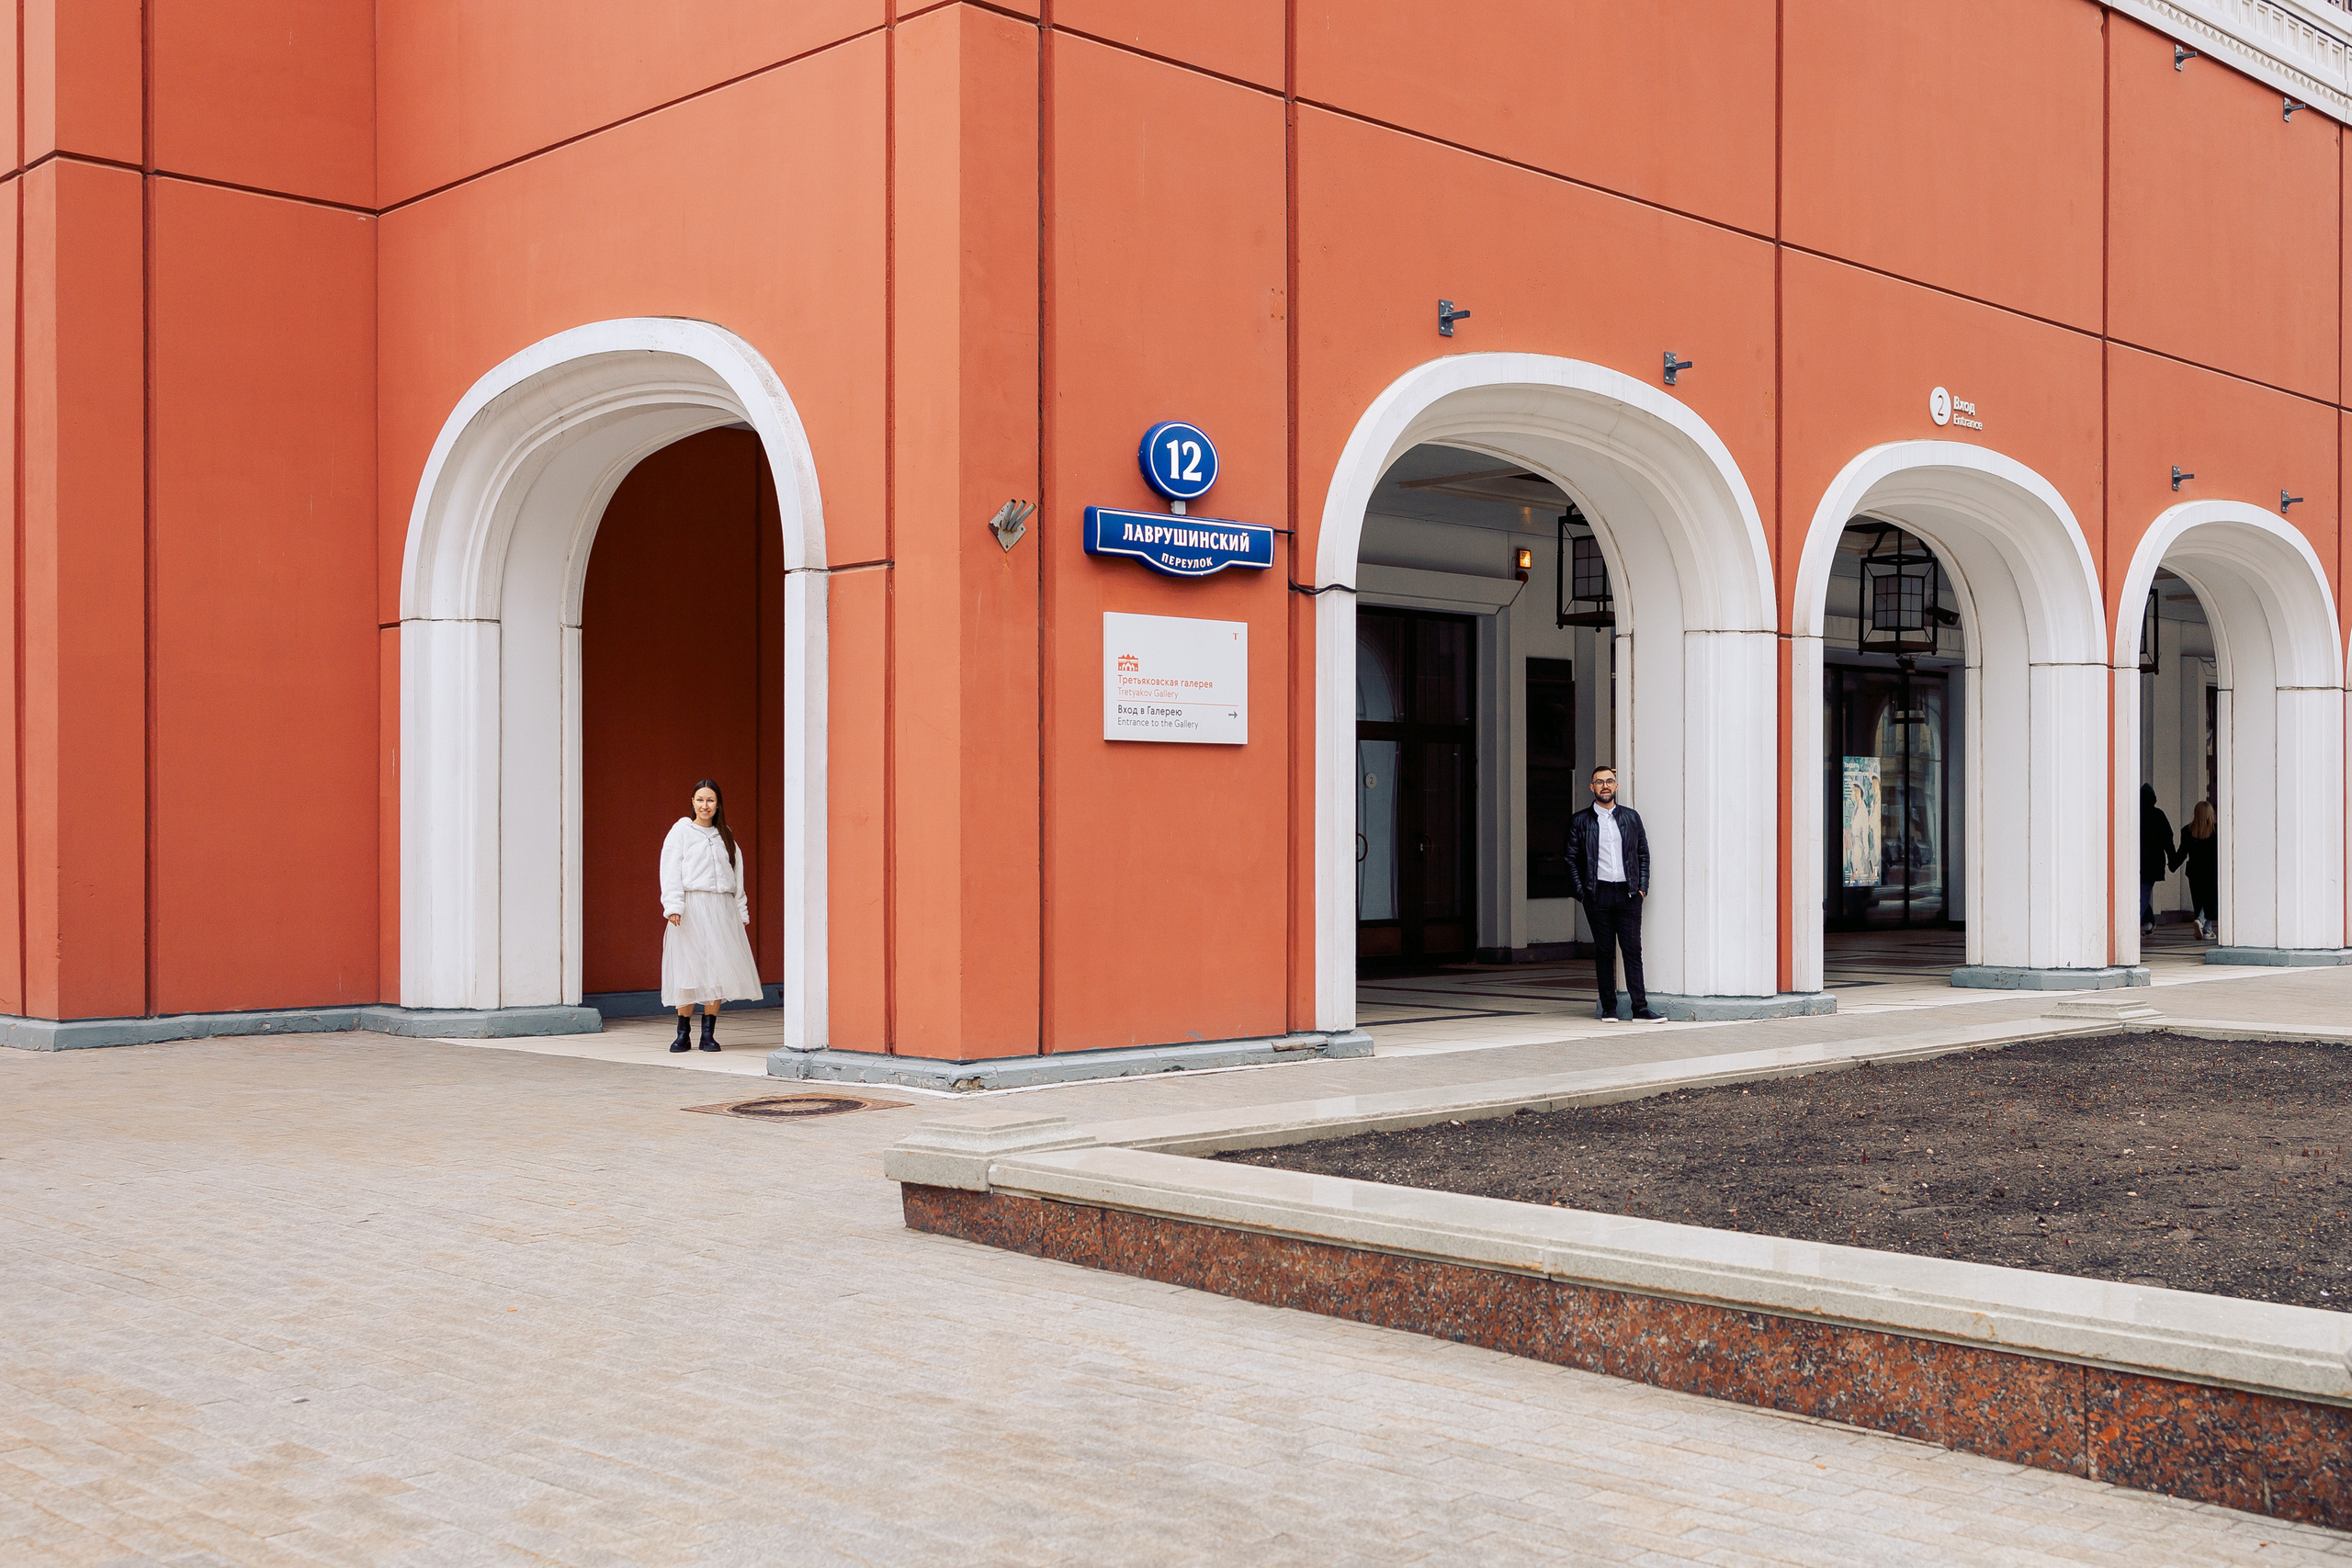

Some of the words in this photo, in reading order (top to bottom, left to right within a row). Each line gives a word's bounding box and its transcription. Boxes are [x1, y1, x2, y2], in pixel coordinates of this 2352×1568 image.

[1938, 395, 1944, 416] 2
[1953, 395, 1975, 416] Вход
[1953, 413, 1983, 430] Entrance
[1166, 439, 1203, 482] 12
[1122, 523, 1250, 553] ЛАВРУШИНСКИЙ
[1160, 552, 1214, 570] ПЕРЕУЛОК
[1117, 674, 1179, 687] Третьяковская
[1181, 679, 1213, 690] галерея
[1117, 687, 1153, 698] Tretyakov
[1153, 689, 1179, 700] Gallery
[1117, 705, 1138, 716] Вход
[1147, 705, 1182, 718] Галерею
[1117, 717, 1149, 728] Entrance
[1151, 719, 1159, 728] to
[1160, 719, 1173, 728] the
[1174, 719, 1199, 730] Gallery
